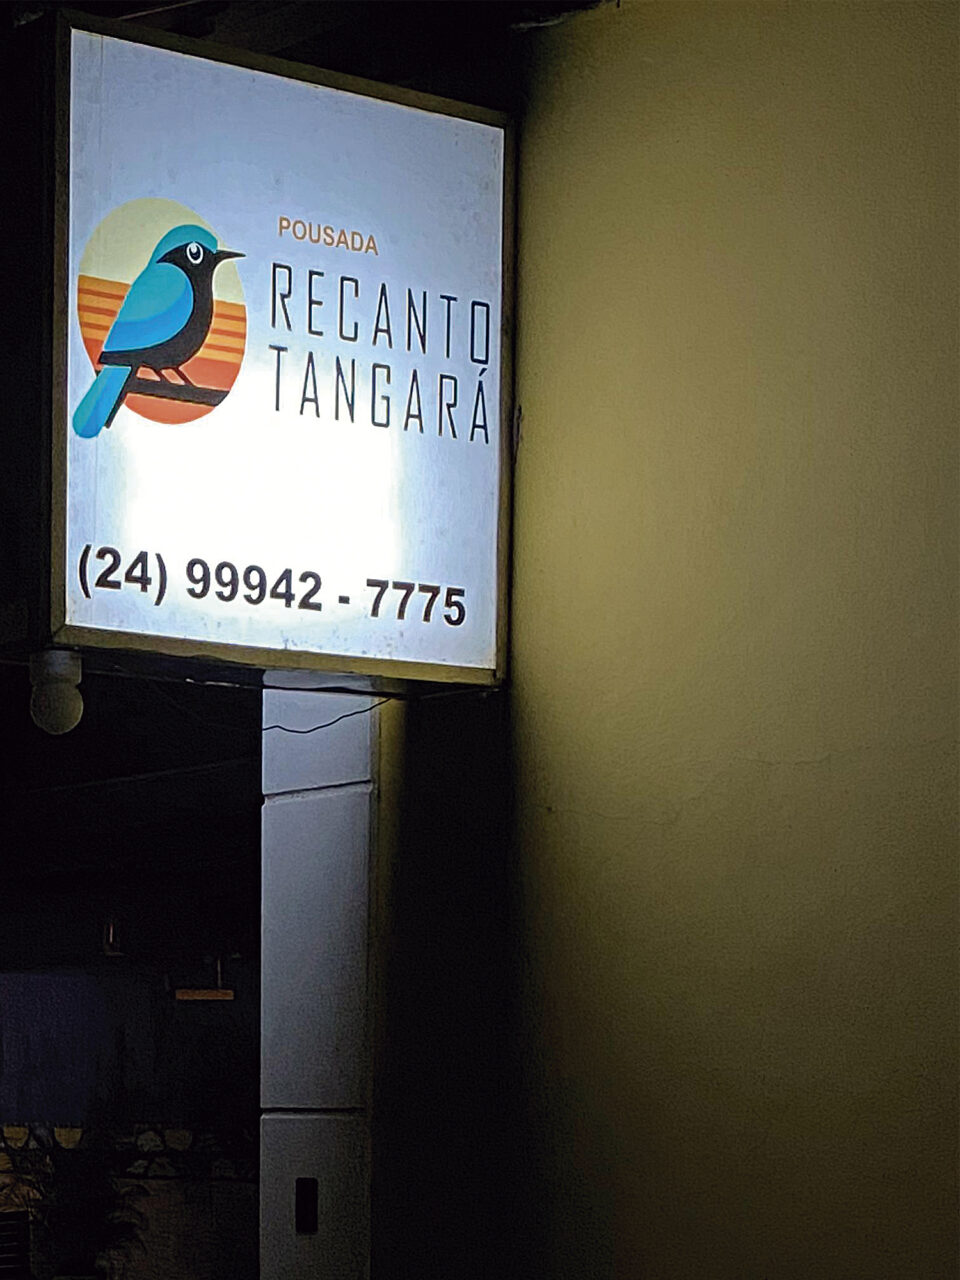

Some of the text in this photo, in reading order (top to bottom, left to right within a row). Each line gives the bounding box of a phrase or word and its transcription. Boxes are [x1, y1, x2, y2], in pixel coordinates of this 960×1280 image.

[279, 216, 378, 255] POUSADA
[270, 262, 490, 365] RECANTO
[269, 345, 489, 444] TANGARÁ
[79, 544, 167, 605] (24)
[186, 558, 322, 610] 99942
[366, 579, 465, 626] 7775
